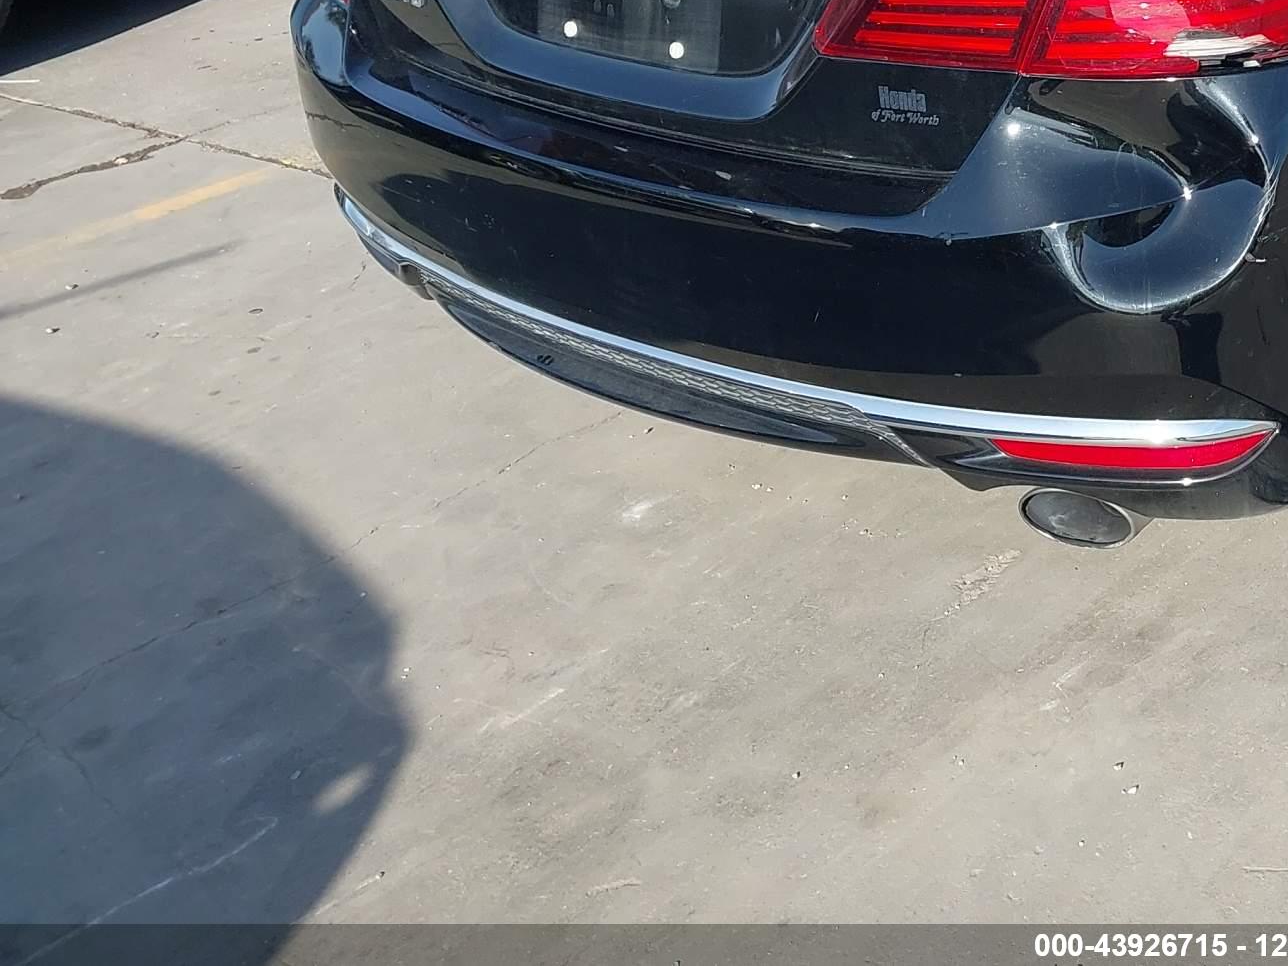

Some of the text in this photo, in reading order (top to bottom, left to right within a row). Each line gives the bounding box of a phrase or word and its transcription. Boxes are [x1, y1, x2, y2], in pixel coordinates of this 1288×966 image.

[878, 86, 927, 113] Honda
[871, 109, 940, 126] of Fort Worth
